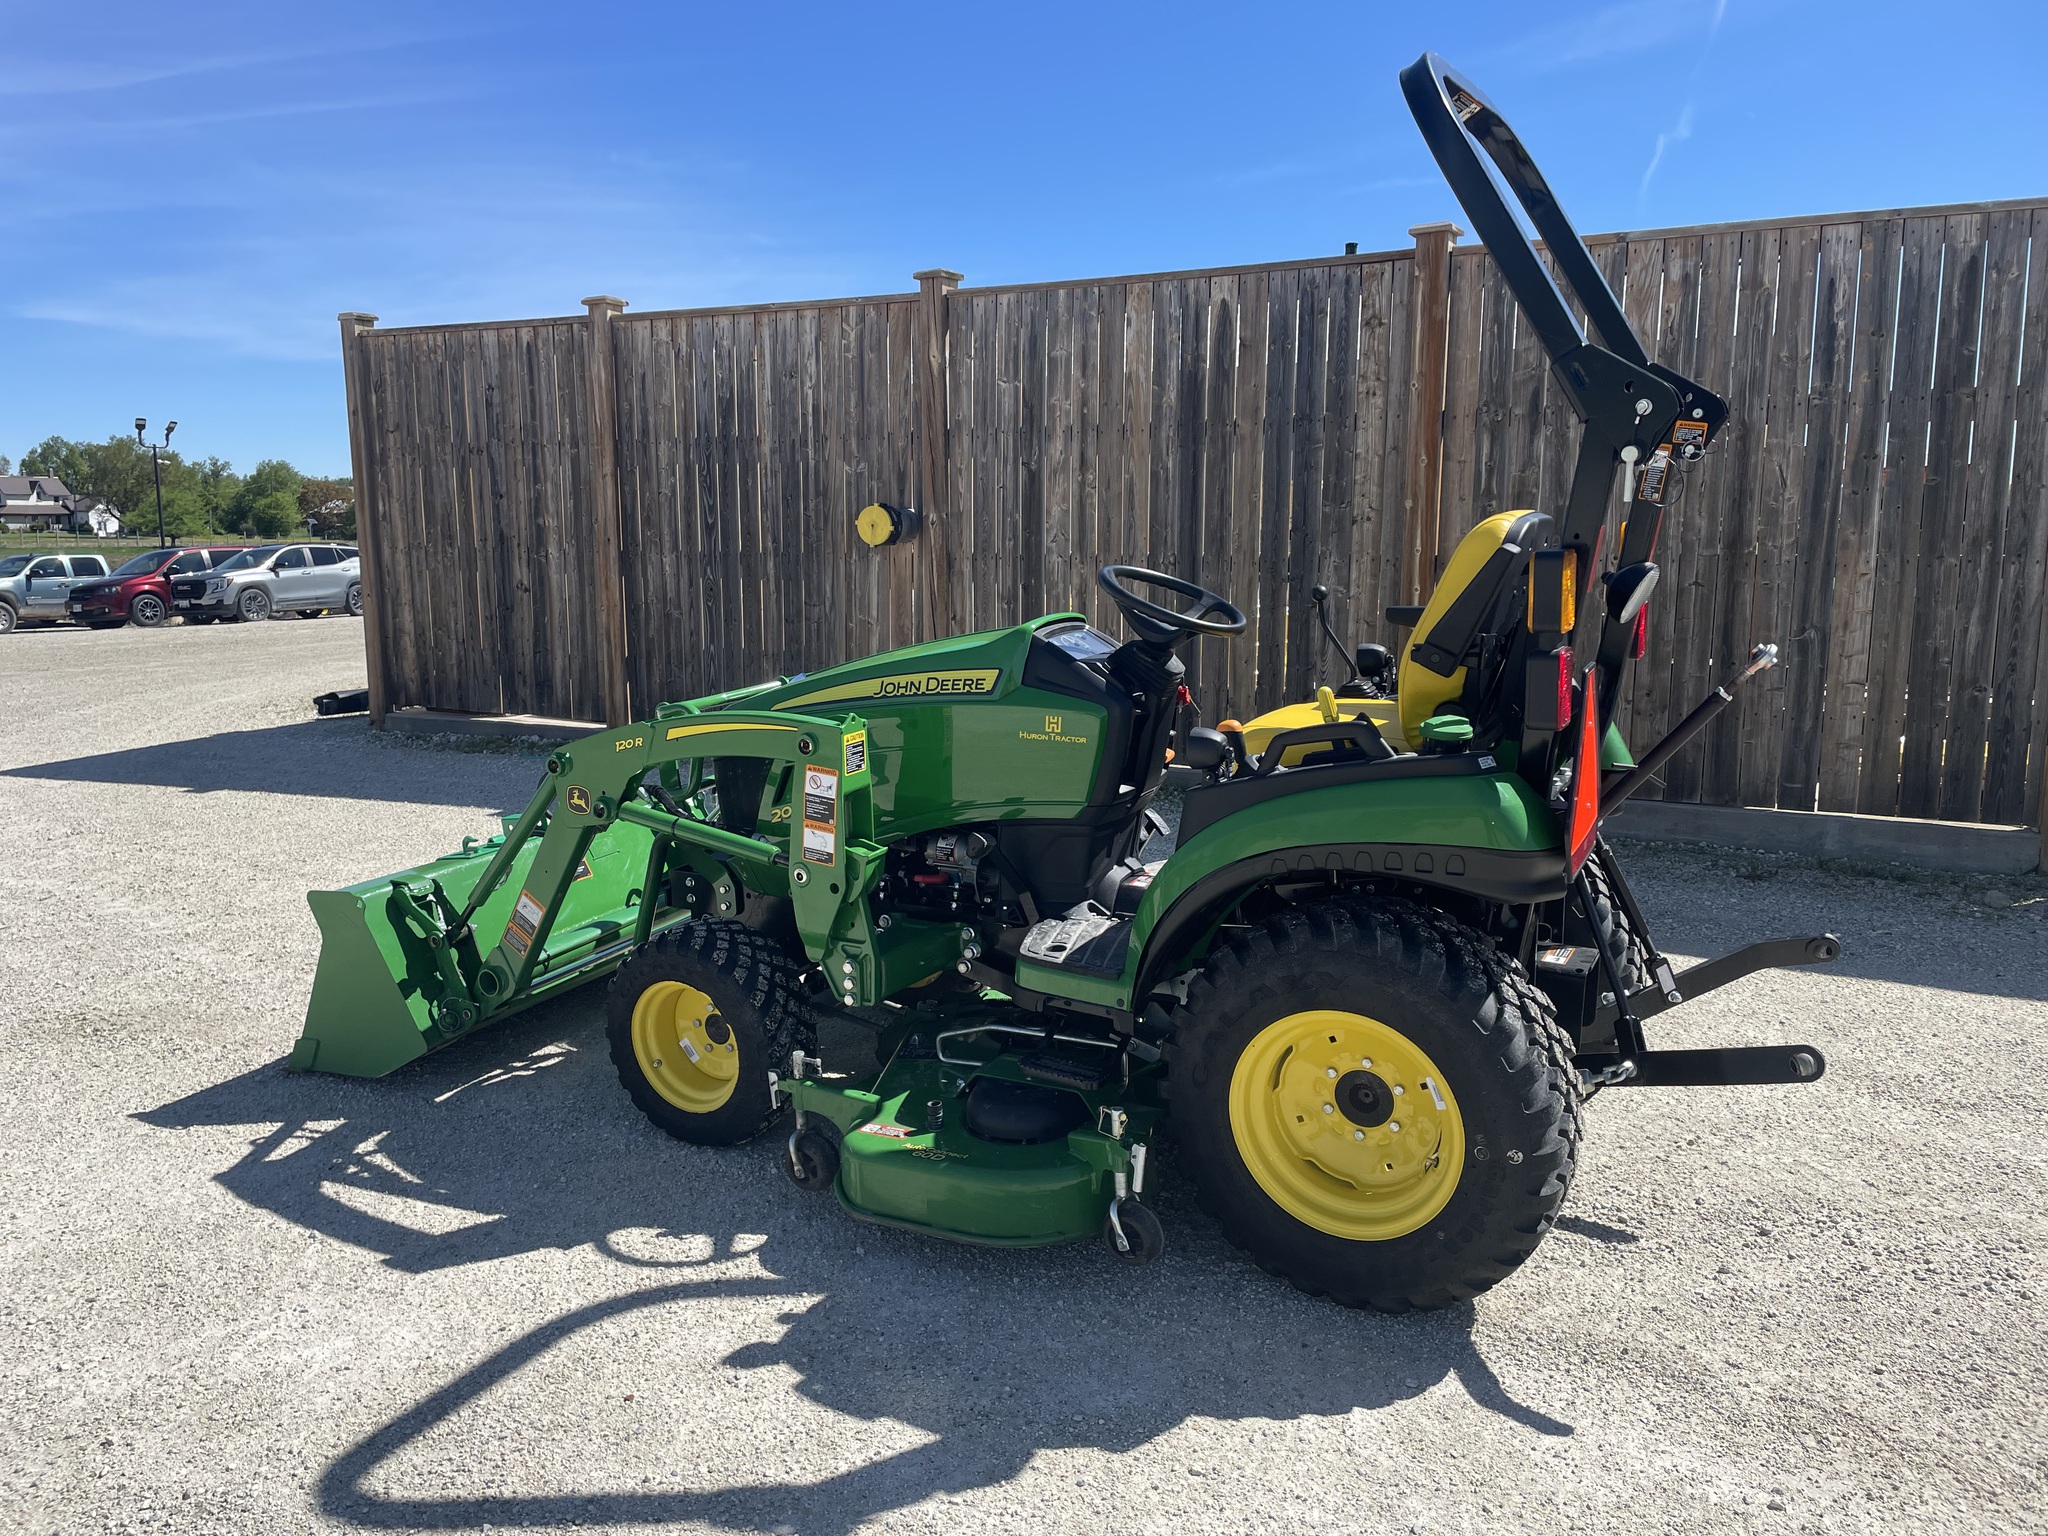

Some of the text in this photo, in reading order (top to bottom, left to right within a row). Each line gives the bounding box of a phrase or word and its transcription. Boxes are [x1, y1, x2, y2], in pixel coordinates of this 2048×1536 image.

[873, 676, 987, 696] JOHN DEERE
[1019, 730, 1087, 744] HURON TRACTOR
[615, 737, 643, 752] 120 R
[812, 766, 837, 776] WARNING
[809, 824, 834, 834] WARNING
